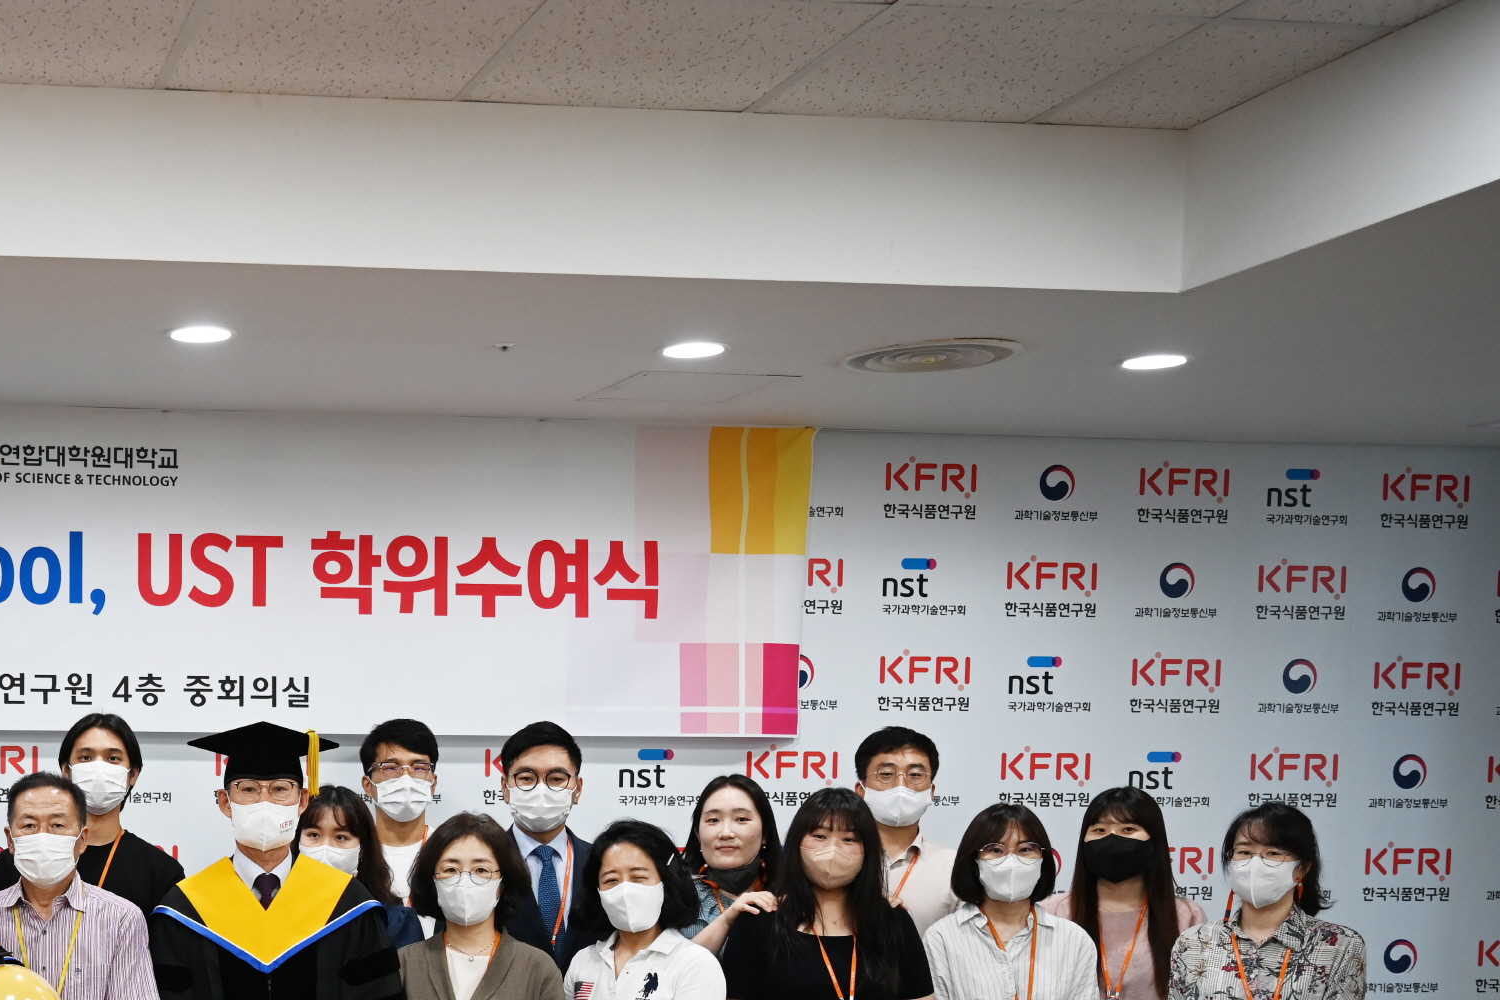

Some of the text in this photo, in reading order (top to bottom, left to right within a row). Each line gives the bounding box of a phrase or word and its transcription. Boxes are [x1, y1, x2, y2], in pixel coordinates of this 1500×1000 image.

[16, 473, 76, 484] SCIENCE
[75, 474, 83, 484] &
[87, 475, 178, 486] TECHNOLOGY
[886, 461, 977, 492] KFRI
[1140, 466, 1230, 498] KFRI
[1383, 472, 1470, 502] KFRI
[1267, 484, 1311, 507] nst
[884, 504, 975, 519] 한국식품연구원
[1015, 510, 1097, 521] 과학기술정보통신부
[1138, 508, 1228, 523] 한국식품연구원
[1266, 514, 1347, 525] 국가과학기술연구회
[1381, 514, 1468, 529] 한국식품연구원
[138, 533, 283, 607] UST
[311, 531, 659, 619] 학위수여식
[1007, 562, 1097, 592] KFRI
[1258, 564, 1347, 593] KFRI
[883, 574, 928, 597] nst
[882, 605, 965, 615] 국가과학기술연구회
[1005, 602, 1096, 617] 한국식품연구원
[1135, 608, 1216, 618] 과학기술정보통신부
[1256, 605, 1345, 620] 한국식품연구원
[1377, 612, 1457, 622] 과학기술정보통신부
[880, 656, 970, 684] KFRI
[1132, 657, 1221, 688] KFRI
[1374, 662, 1461, 691] KFRI
[1009, 672, 1053, 694] nst
[112, 674, 165, 706] 4층
[184, 676, 309, 708] 중회의실
[799, 699, 838, 711] 보통신부
[878, 697, 969, 711] 한국식품연구원
[1008, 702, 1090, 712] 국가과학기술연구회
[1130, 699, 1219, 713] 한국식품연구원
[1258, 703, 1338, 713] 과학기술정보통신부
[1372, 702, 1459, 716] 한국식품연구원
[746, 751, 838, 779] KFRI
[1001, 751, 1091, 782] KFRI
[1250, 754, 1338, 782] KFRI
[619, 765, 665, 788] nst
[1128, 767, 1173, 790] nst
[999, 791, 1090, 807] 한국식품연구원
[1369, 799, 1447, 808] 과학기술정보통신부
[1365, 848, 1451, 876] KFRI
[1363, 887, 1449, 901] 한국식품연구원
[1365, 982, 1438, 993] 학기술정보통신부
